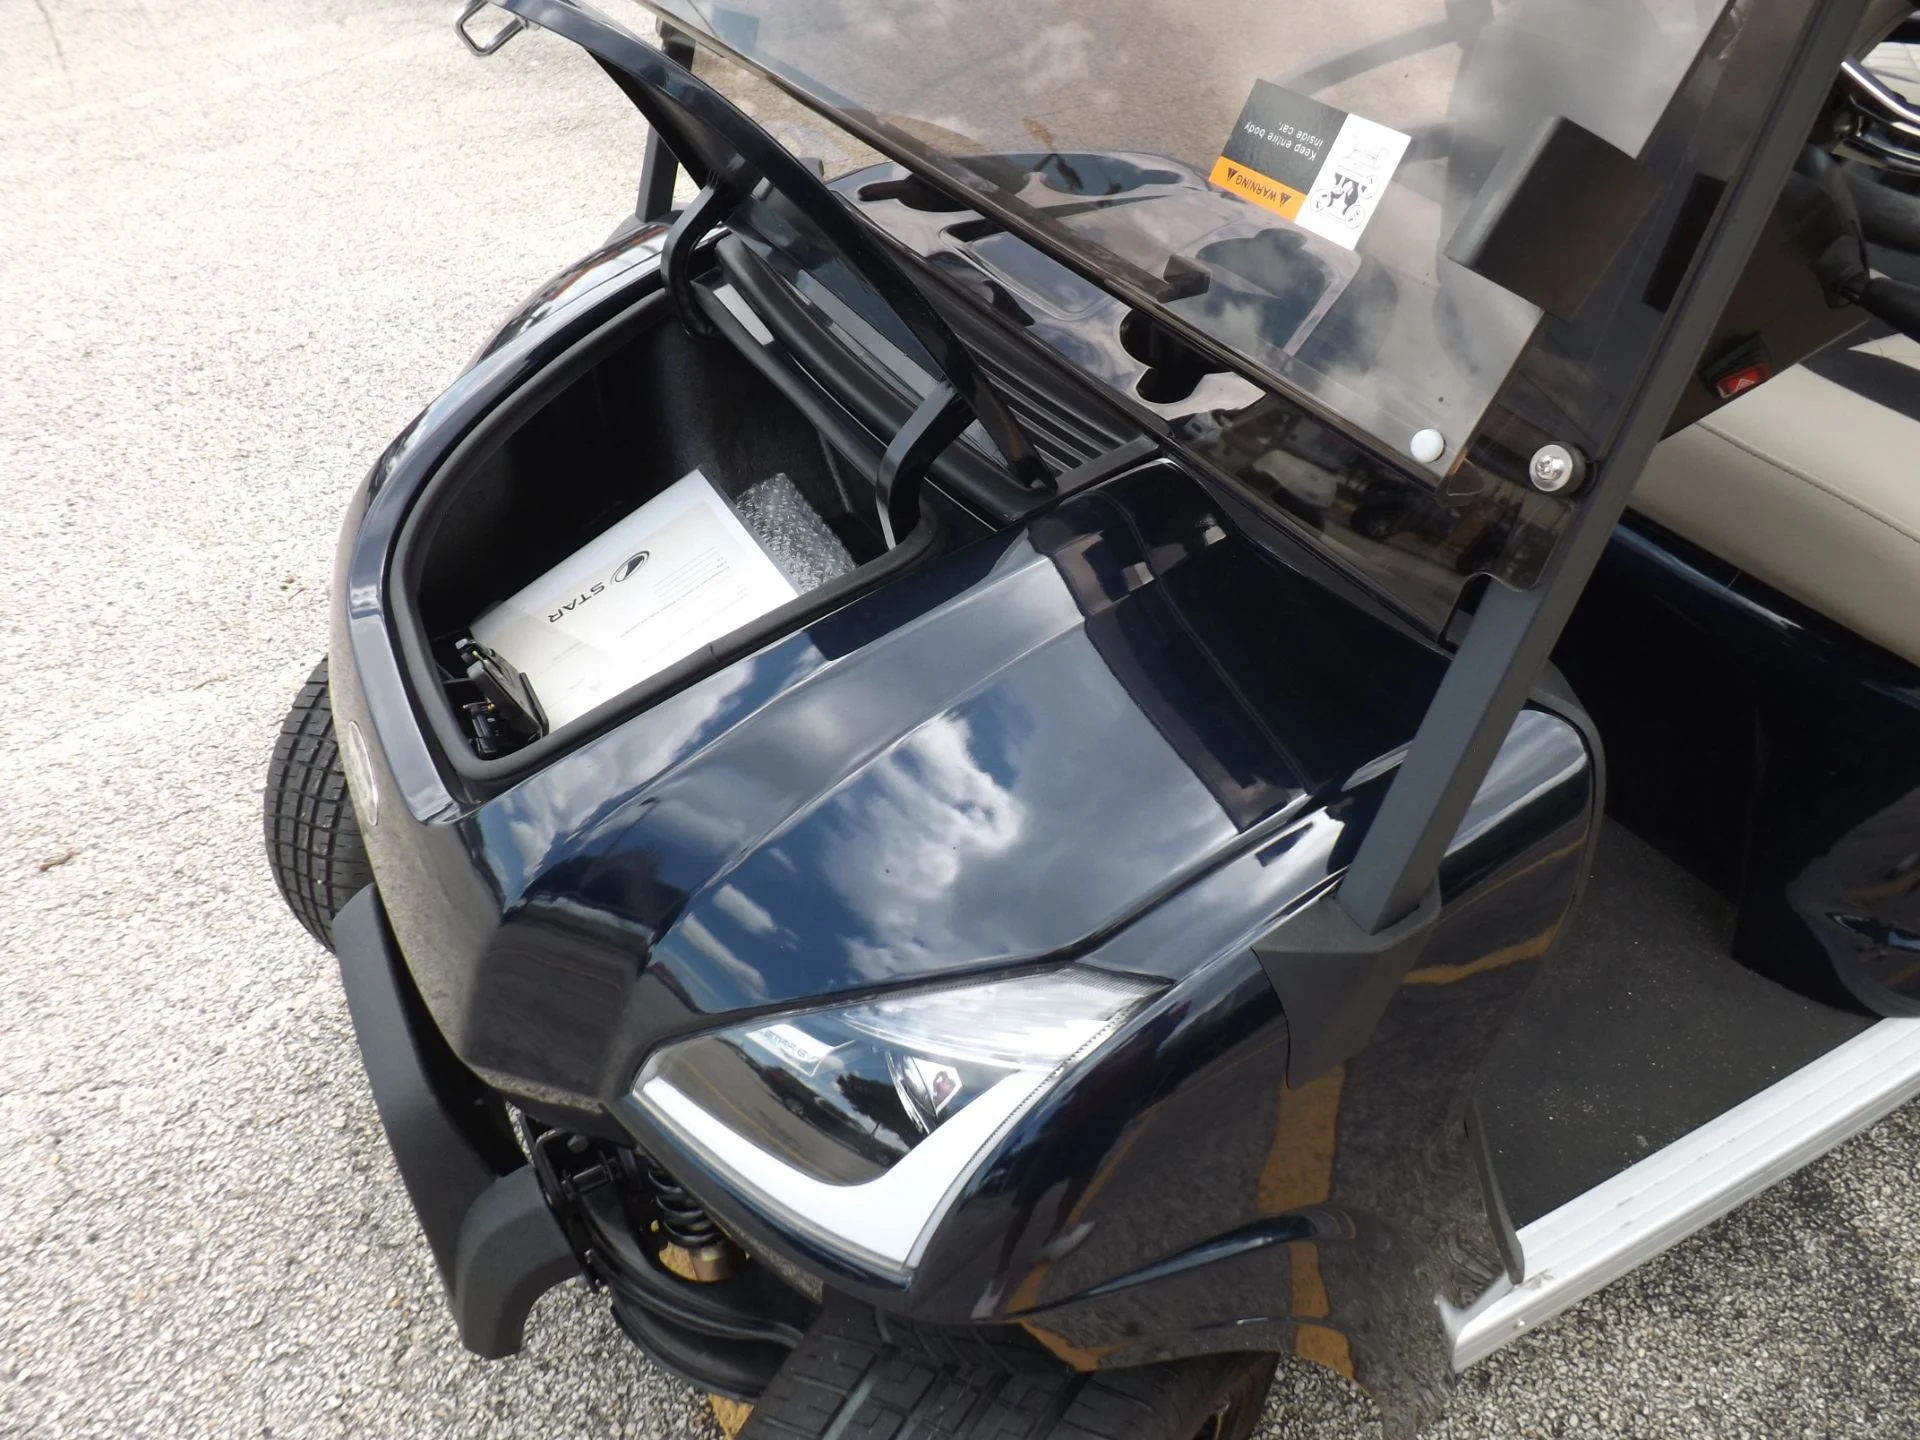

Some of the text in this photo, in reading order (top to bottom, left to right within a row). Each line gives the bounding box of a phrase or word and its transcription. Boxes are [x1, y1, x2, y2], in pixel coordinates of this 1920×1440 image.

[1244, 121, 1317, 161] Keep entire body
[1278, 121, 1324, 148] inside car.
[1235, 175, 1277, 202] WARNING
[547, 581, 606, 623] STAR
